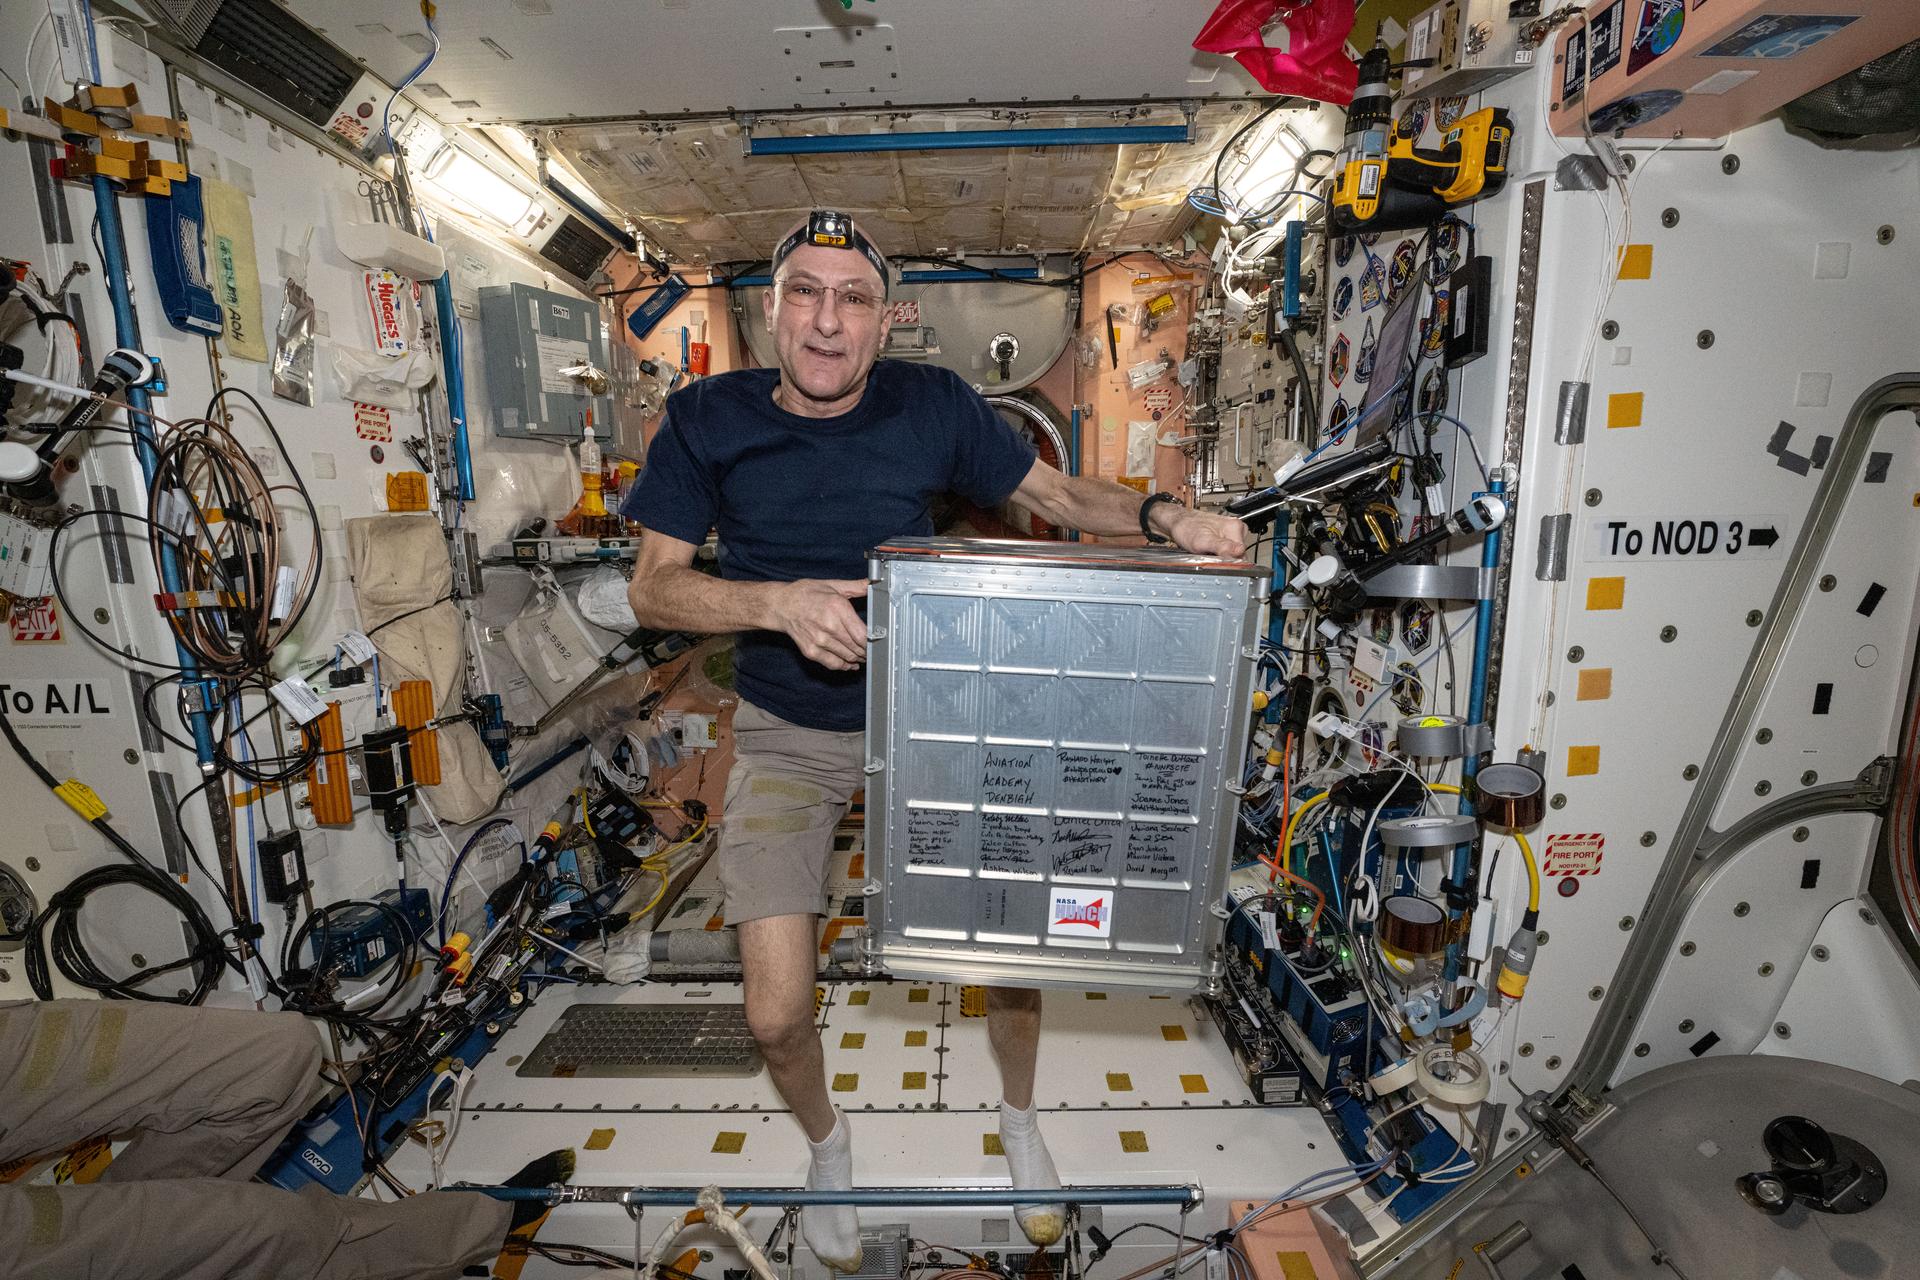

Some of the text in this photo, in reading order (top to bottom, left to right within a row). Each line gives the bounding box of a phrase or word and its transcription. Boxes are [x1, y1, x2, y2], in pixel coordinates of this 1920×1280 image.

[378, 282, 400, 339] HUGGIES
[373, 420, 387, 429] PORT
[1608, 520, 1744, 556] To NOD 3
[45, 684, 110, 714] A/L
[984, 752, 1034, 768] AVIATION
[983, 772, 1031, 793] ACADEMY
[985, 792, 1034, 804] DENBIGH
[1055, 904, 1108, 922] HUNCH
